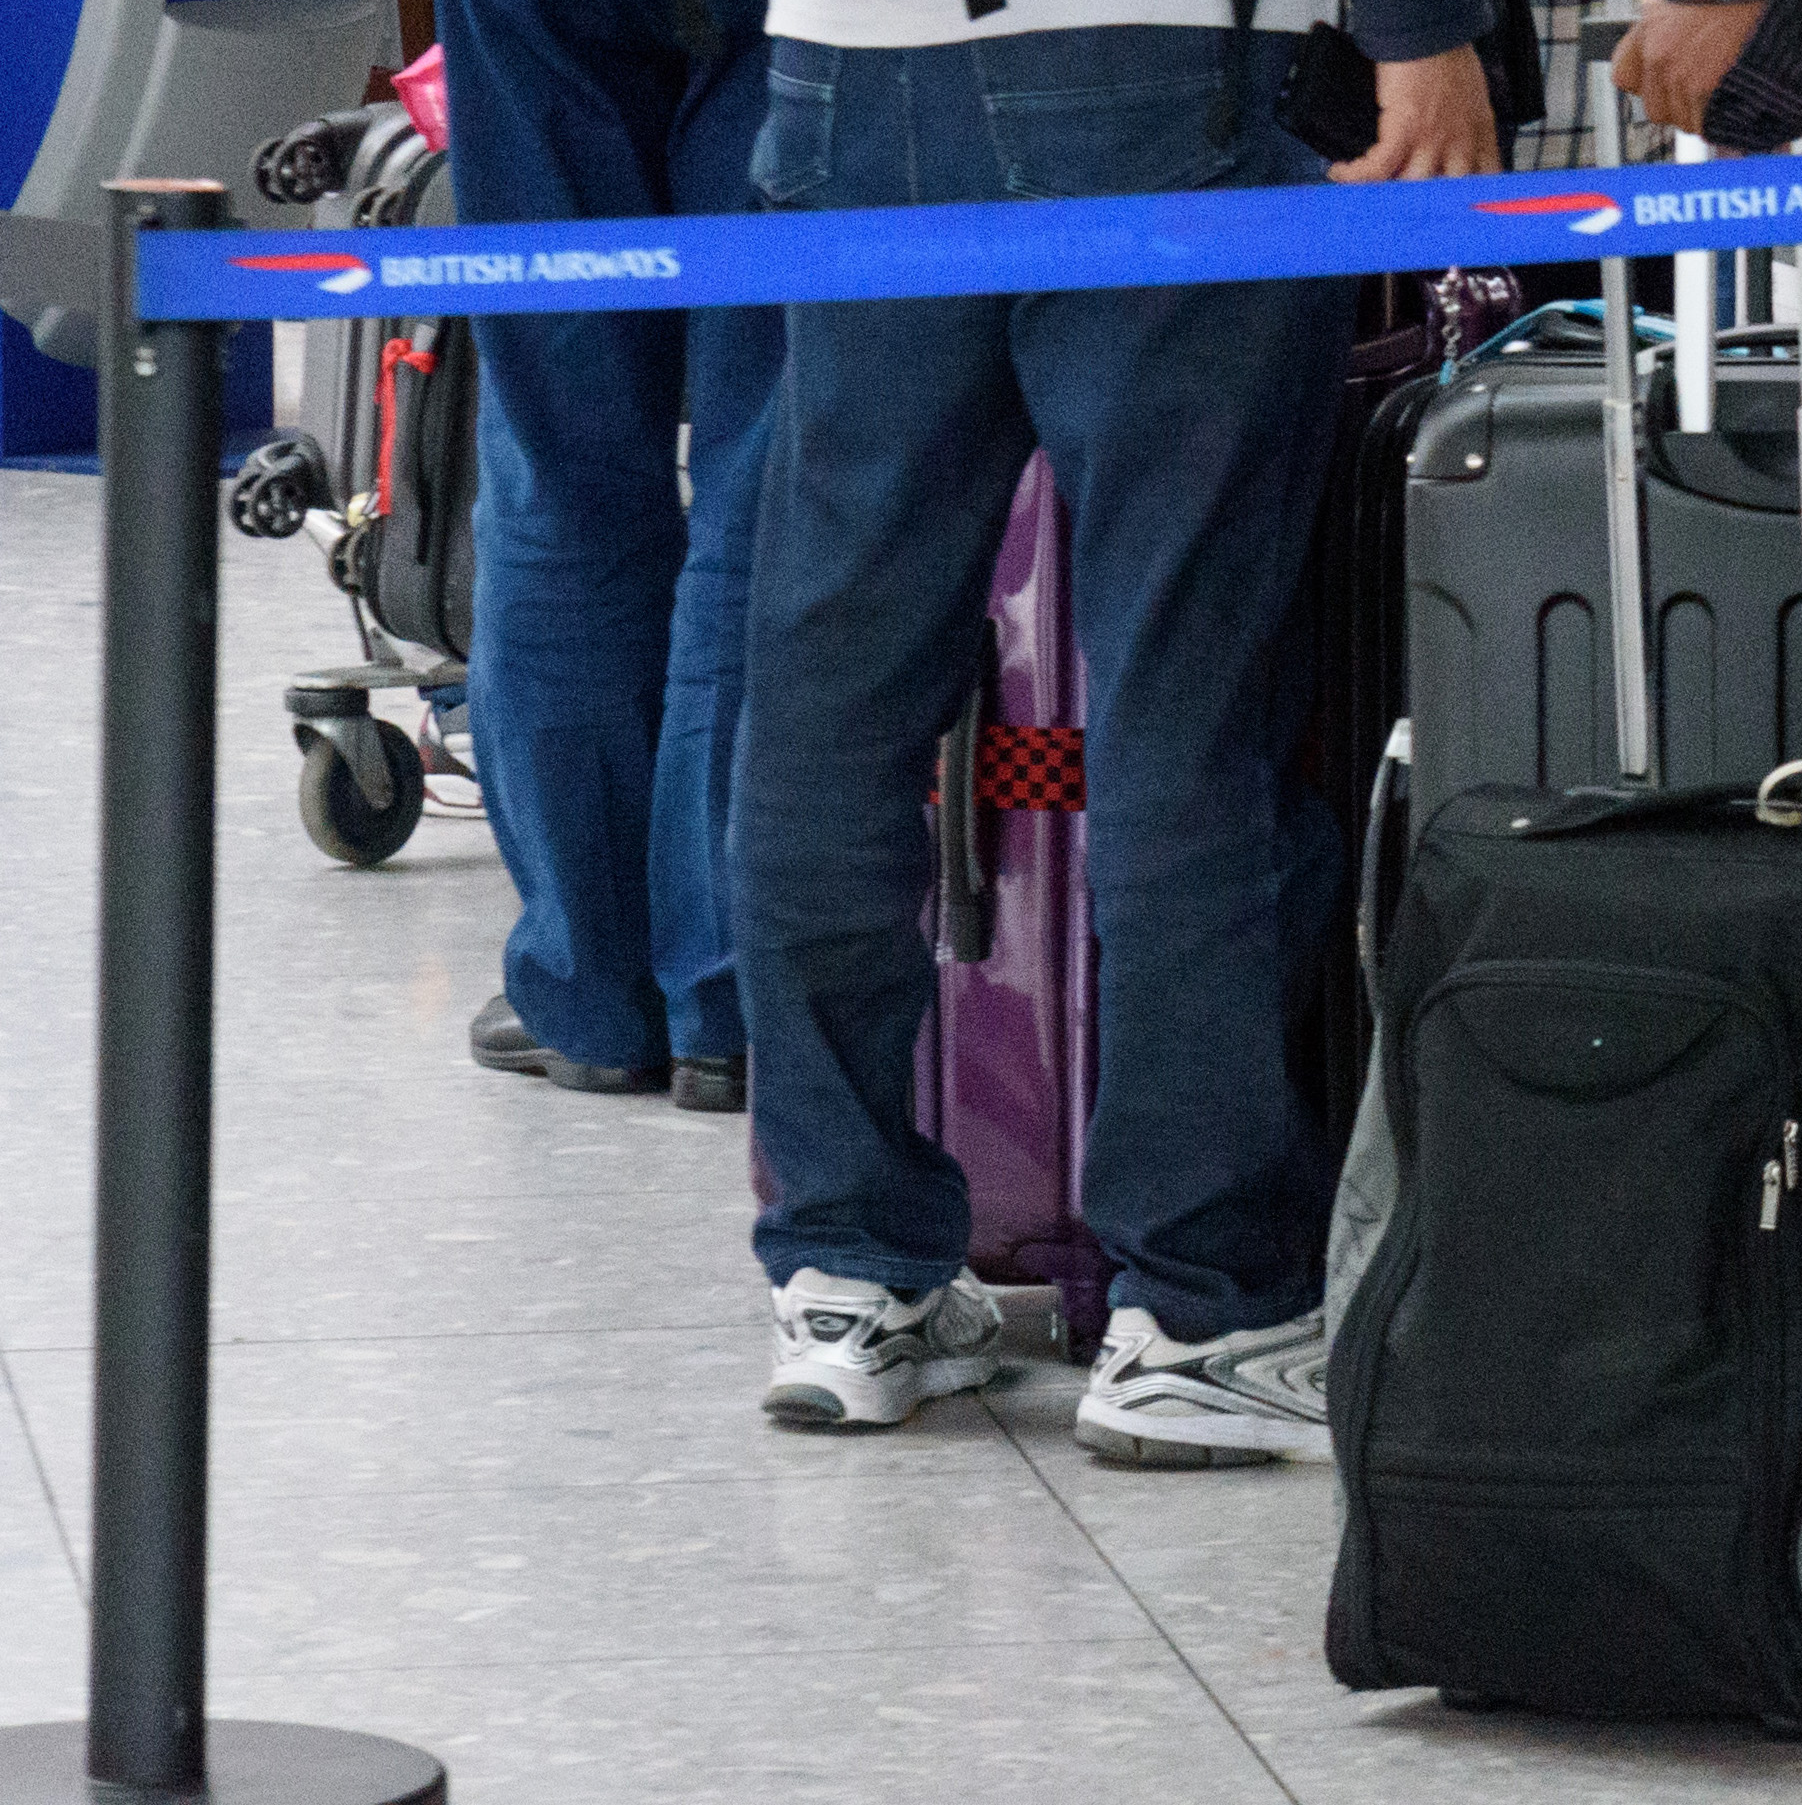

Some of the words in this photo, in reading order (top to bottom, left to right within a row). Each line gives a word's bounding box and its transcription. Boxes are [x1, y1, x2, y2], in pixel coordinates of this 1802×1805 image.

[1632, 185, 1779, 227] BRITISH
[380, 253, 524, 288] BRITISH
[525, 246, 682, 283] AIRWAYS
